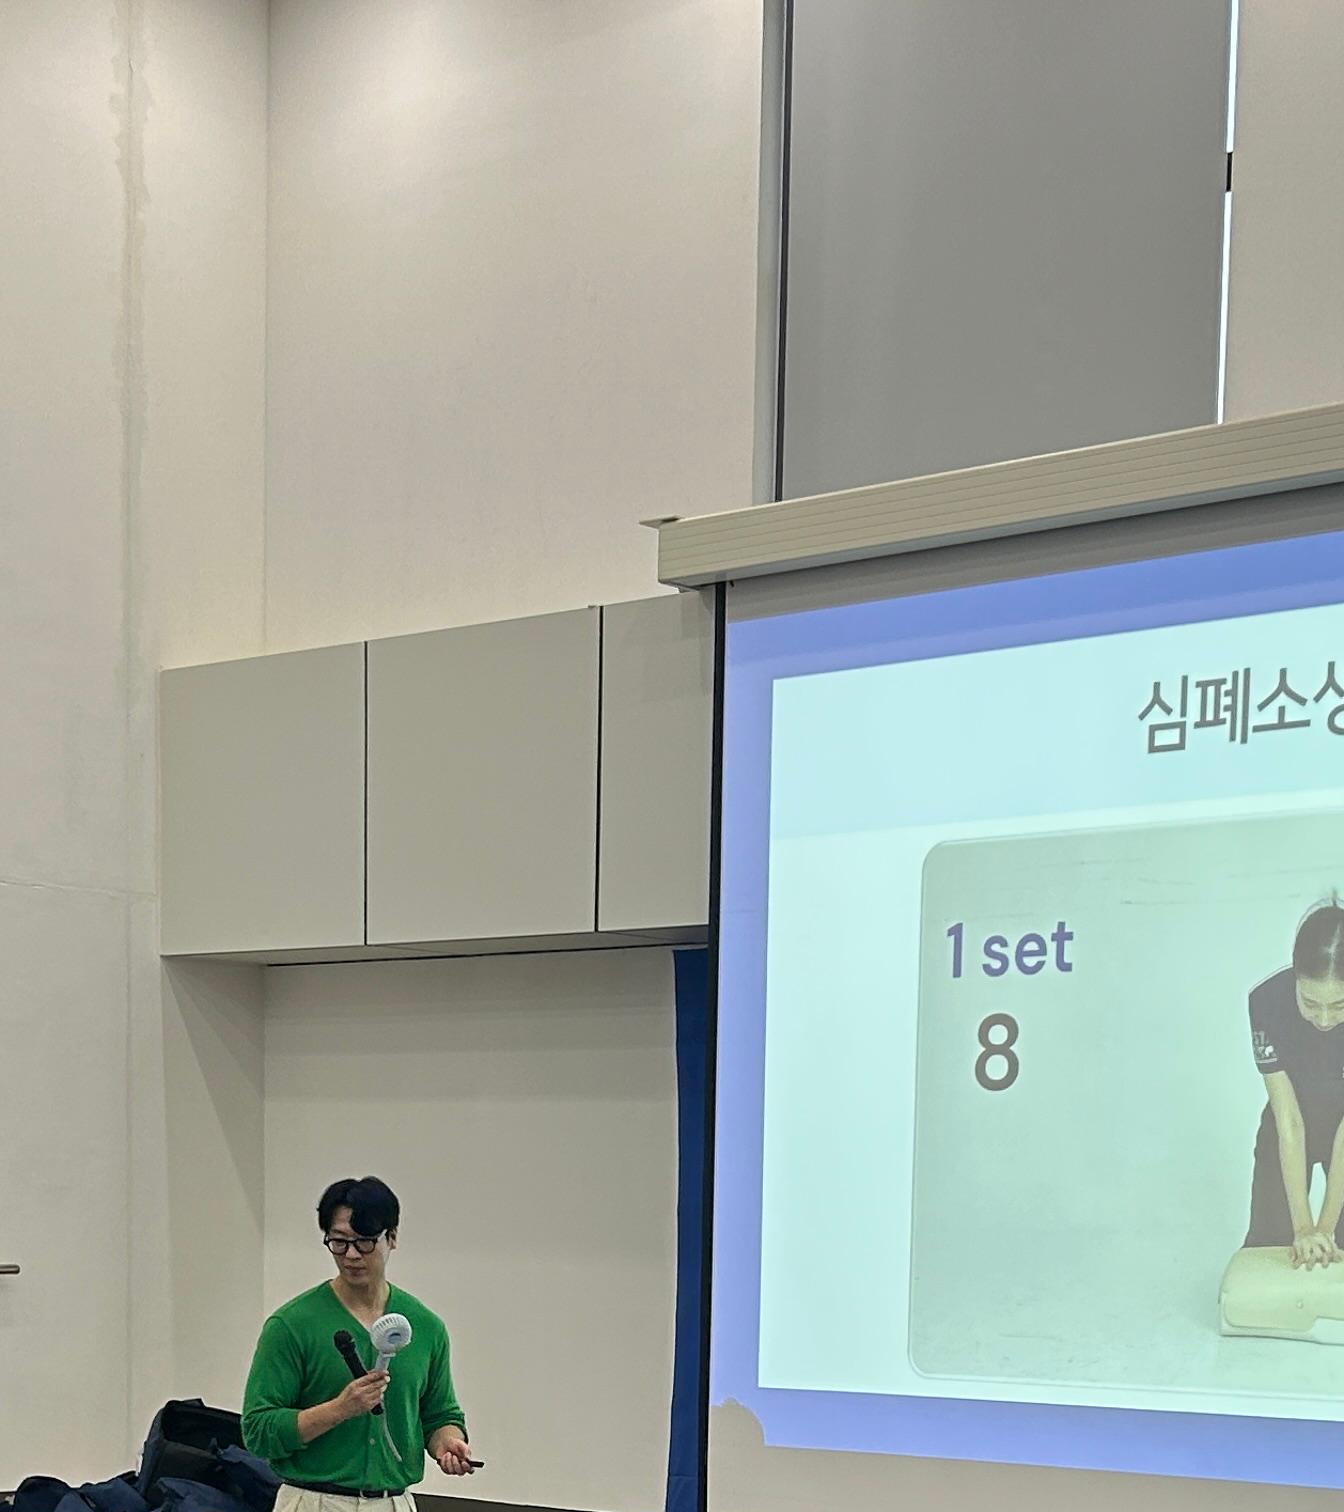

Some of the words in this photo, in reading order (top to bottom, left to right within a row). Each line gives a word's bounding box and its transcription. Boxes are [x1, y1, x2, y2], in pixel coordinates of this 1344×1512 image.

[946, 922, 963, 978] 1
[982, 921, 1074, 978] set
[973, 1013, 1020, 1092] 8
